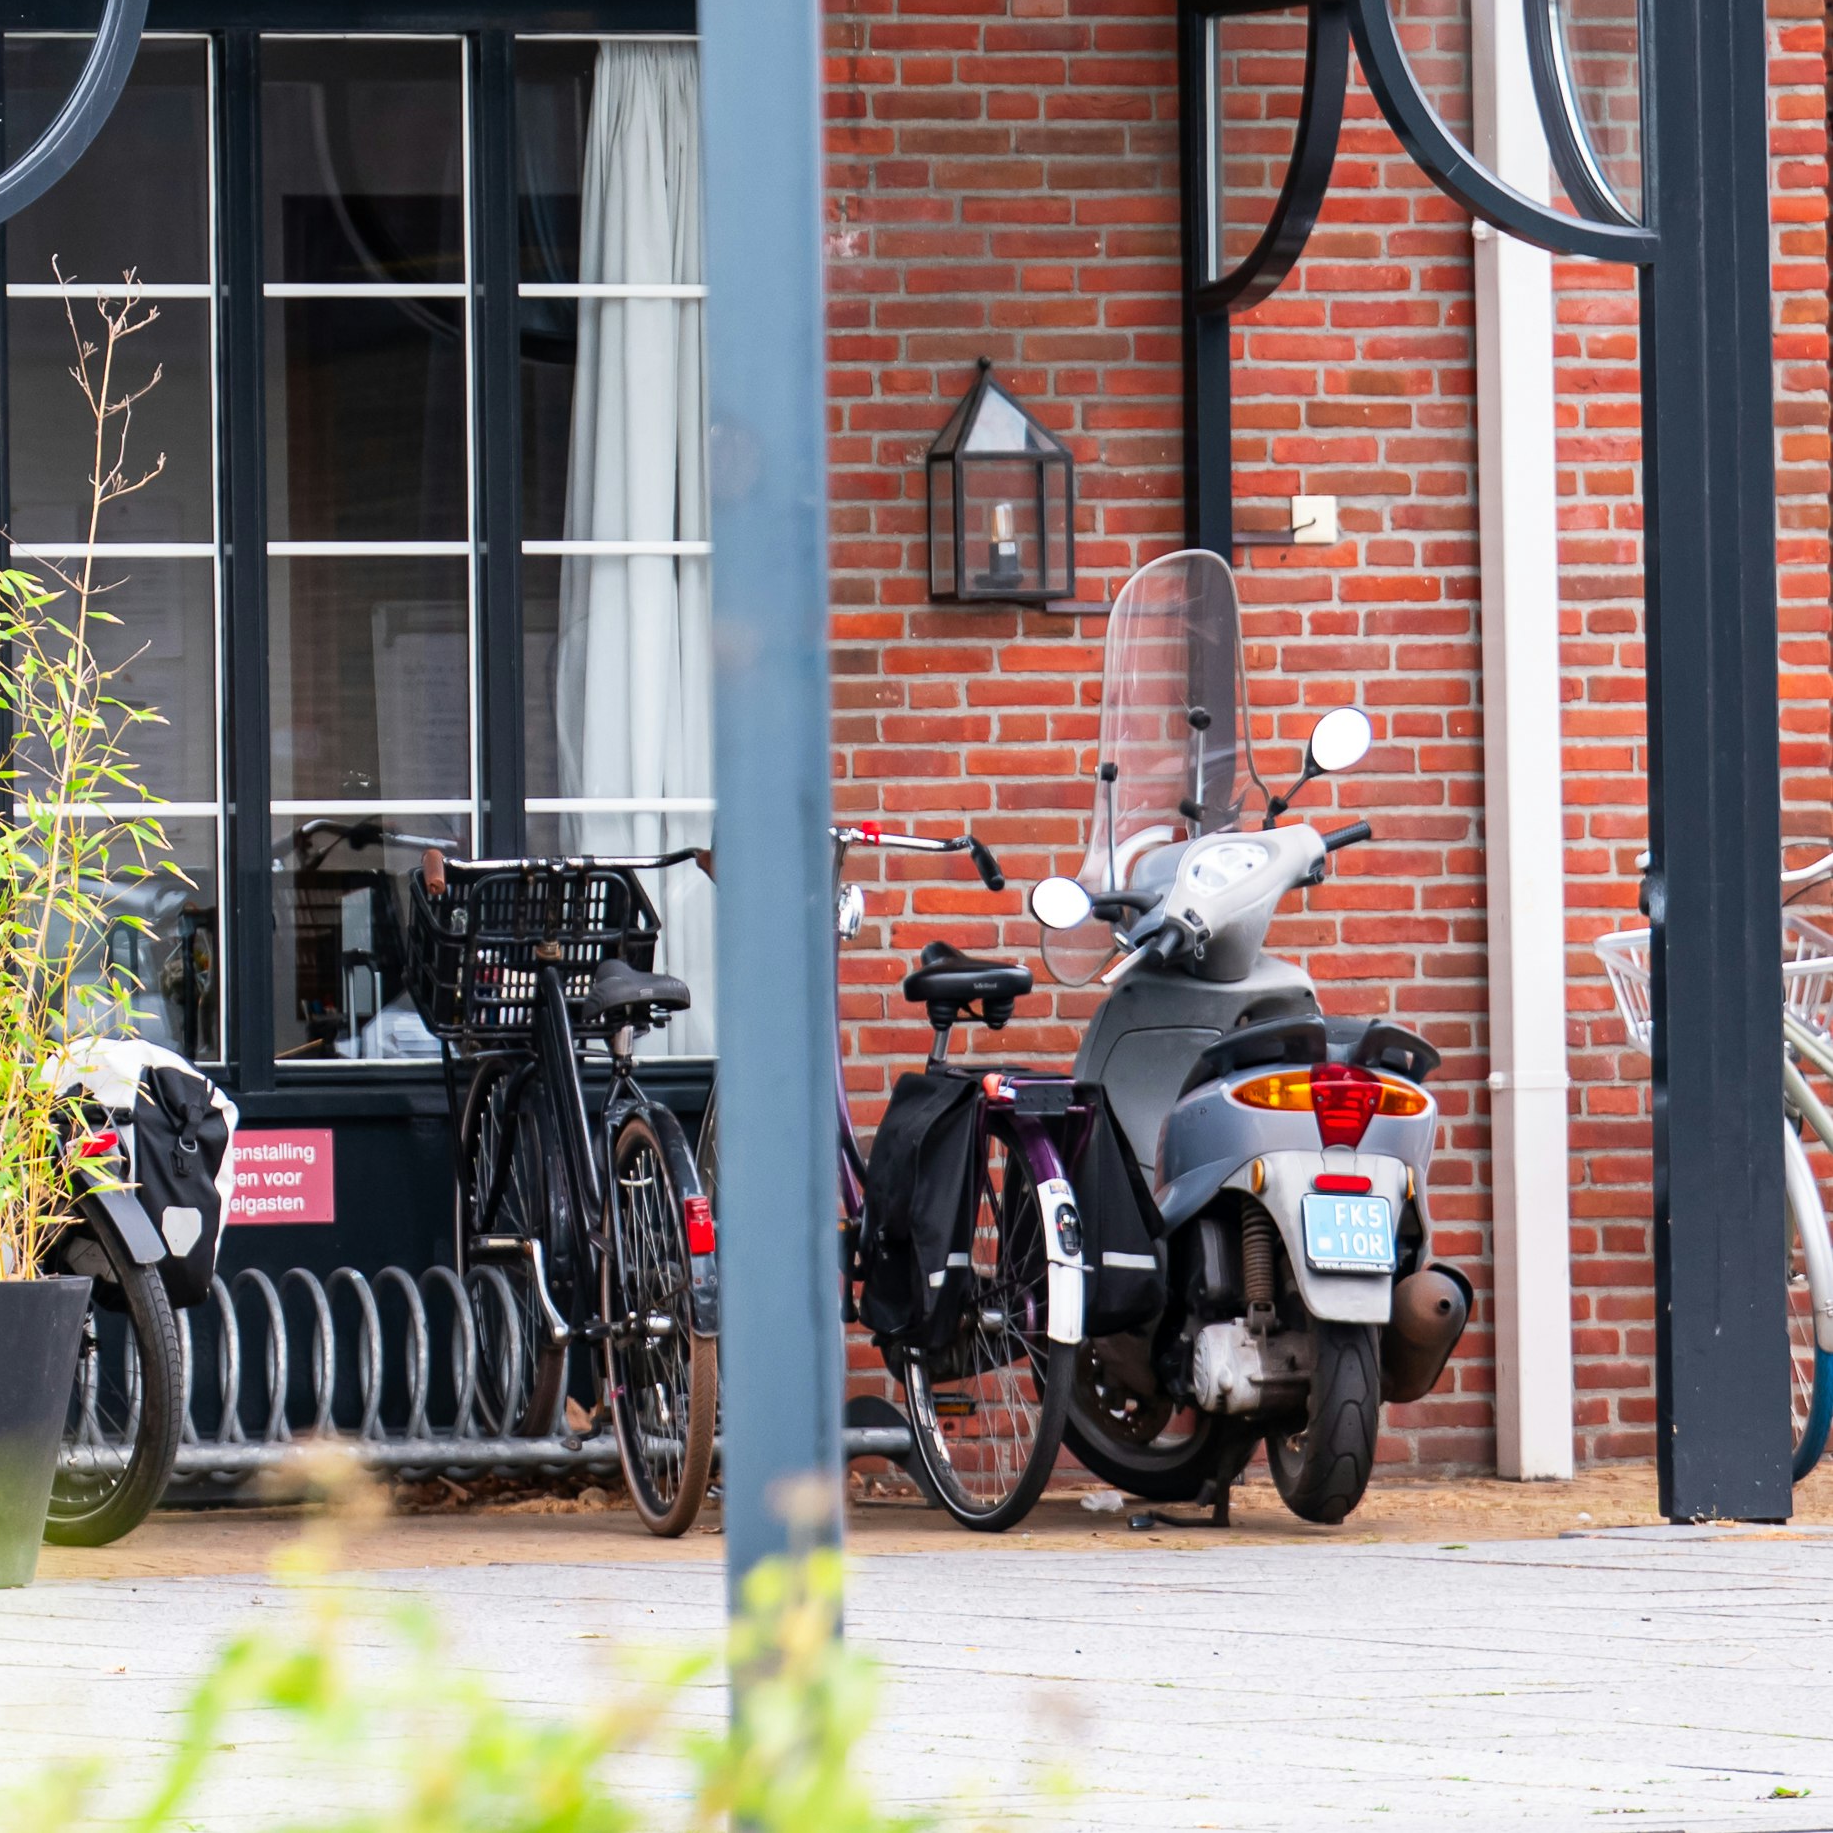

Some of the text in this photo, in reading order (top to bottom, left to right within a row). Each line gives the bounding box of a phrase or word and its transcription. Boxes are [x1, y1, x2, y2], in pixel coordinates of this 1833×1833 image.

[263, 1171, 302, 1186] voor
[1335, 1203, 1382, 1229] FK5
[1339, 1232, 1385, 1256] 10R
